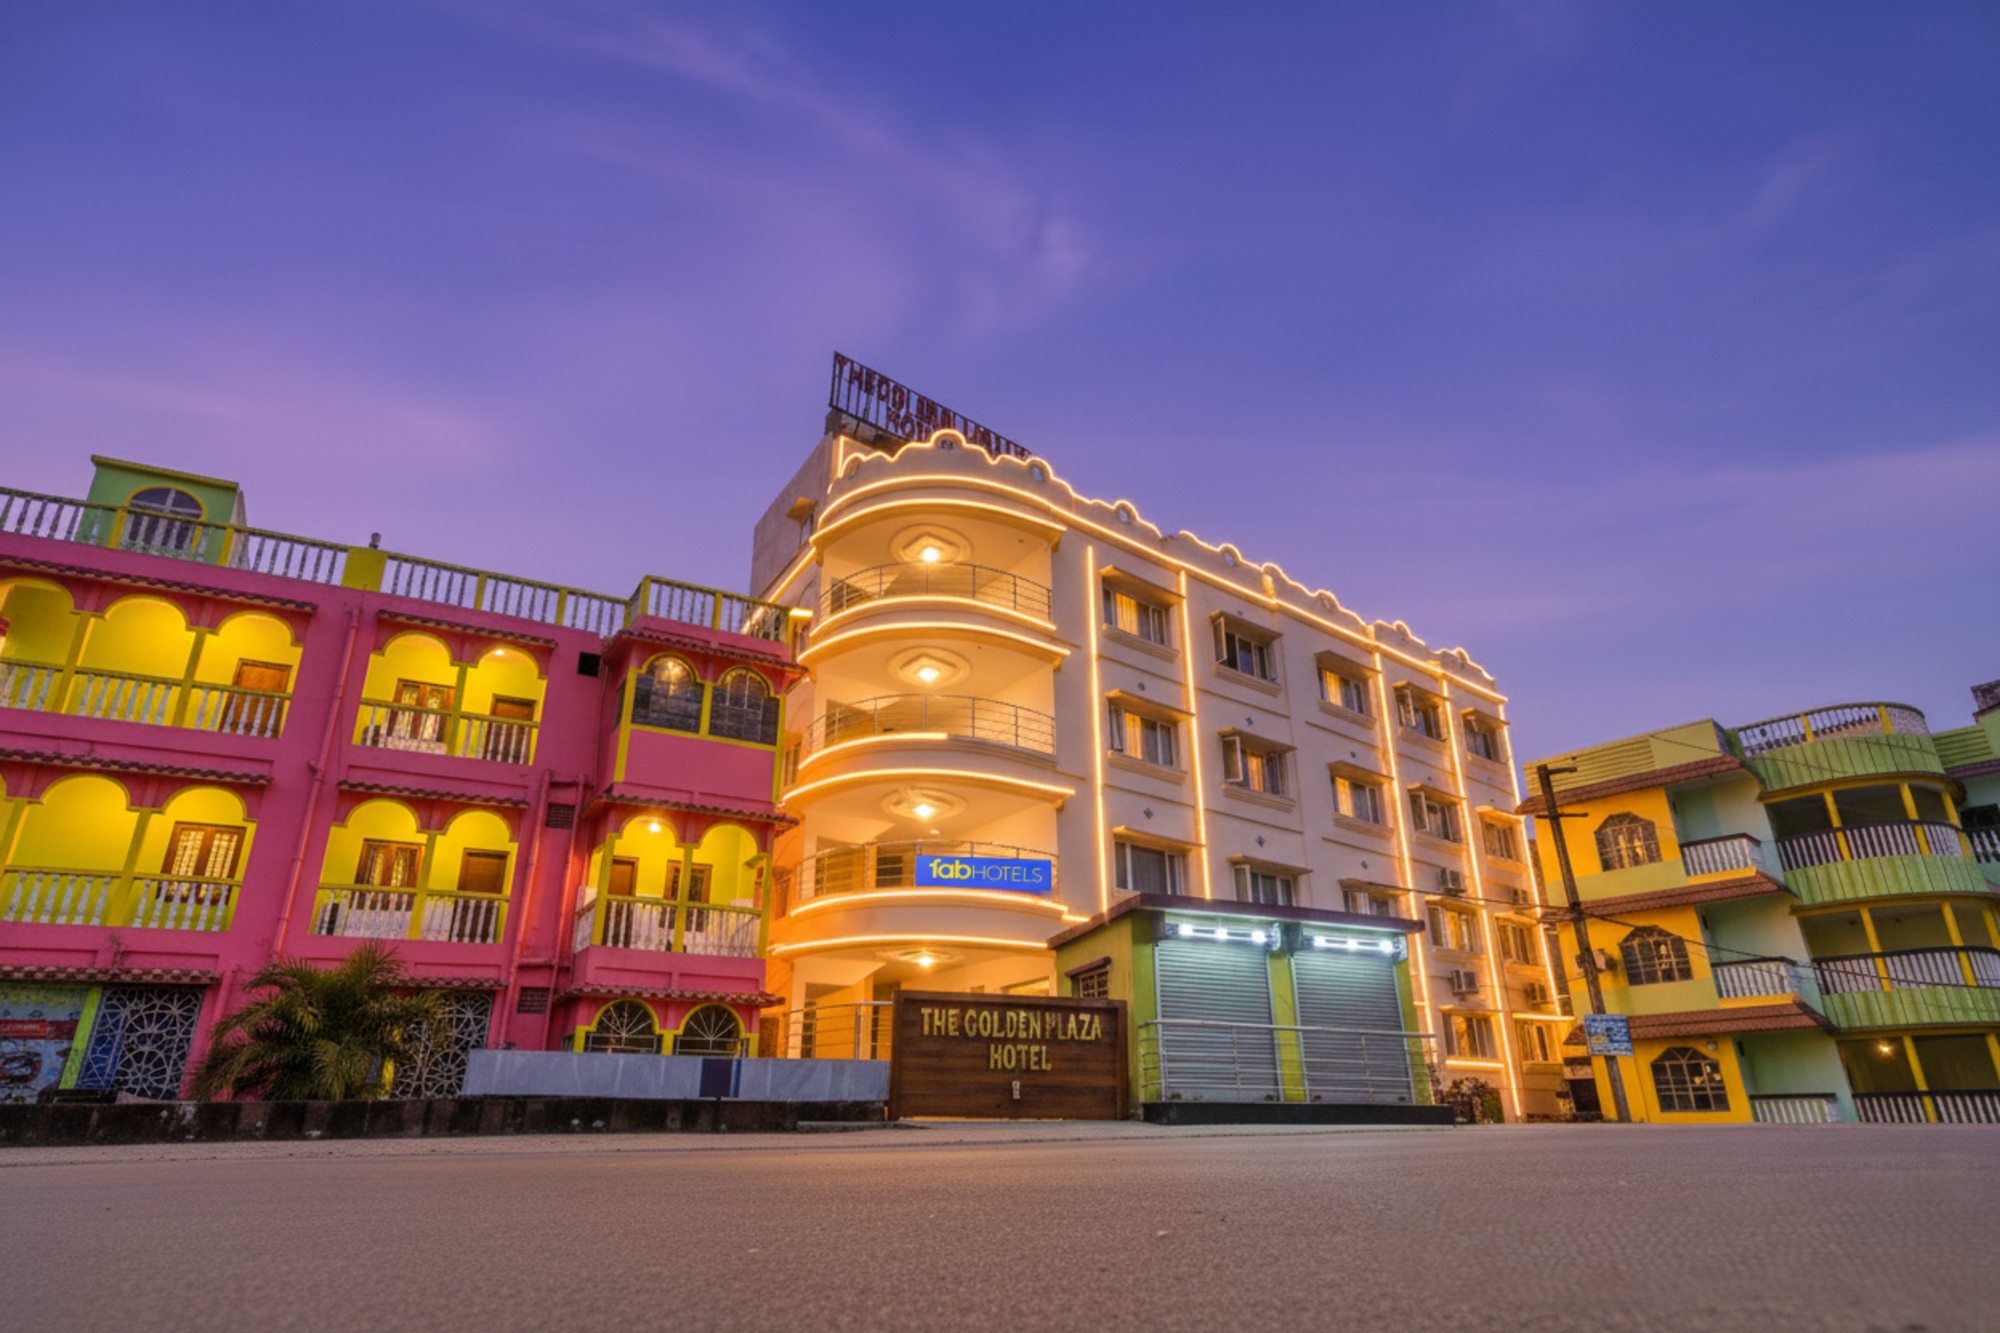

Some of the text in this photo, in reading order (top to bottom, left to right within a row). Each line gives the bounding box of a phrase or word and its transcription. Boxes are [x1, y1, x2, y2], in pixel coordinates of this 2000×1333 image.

[921, 1007, 1102, 1041] THE GOLDEN PLAZA
[989, 1043, 1052, 1071] HOTEL
